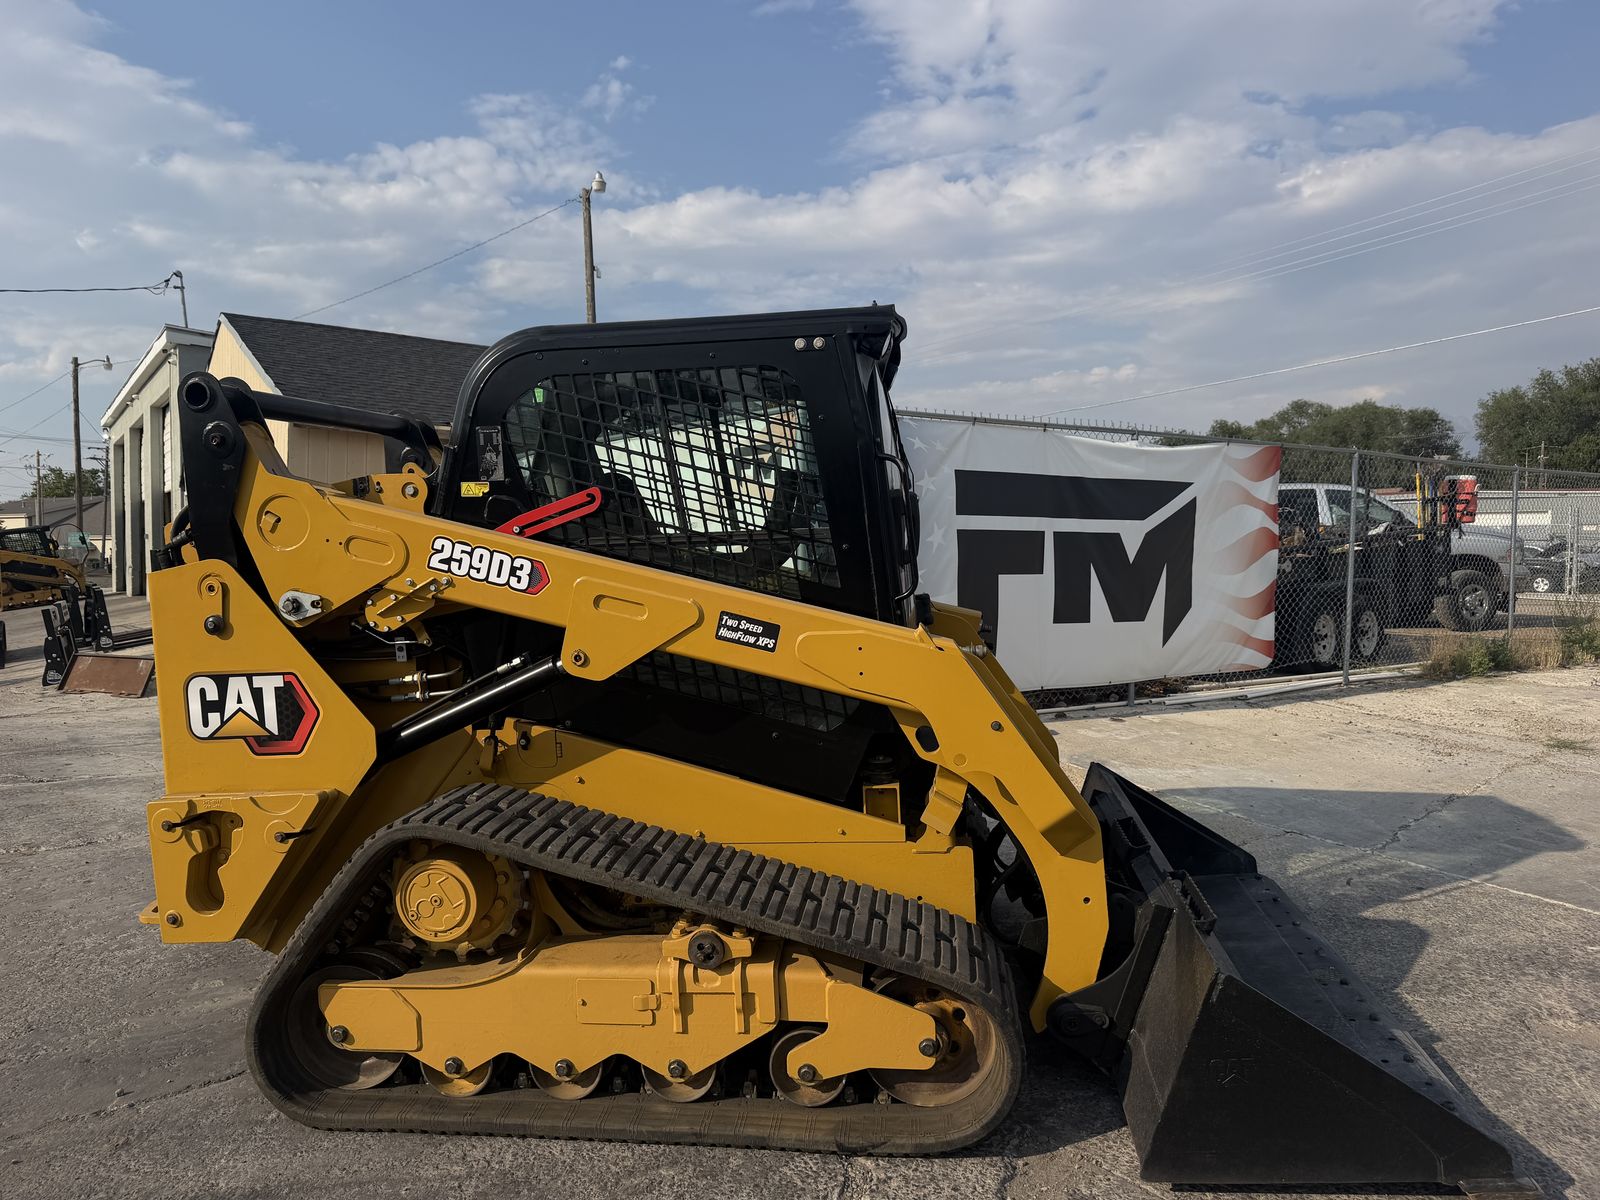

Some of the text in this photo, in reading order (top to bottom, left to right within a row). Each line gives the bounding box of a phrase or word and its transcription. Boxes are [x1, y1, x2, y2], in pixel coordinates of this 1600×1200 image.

[428, 536, 533, 591] 259D3
[756, 636, 776, 649] XPS
[187, 674, 284, 738] CAT
